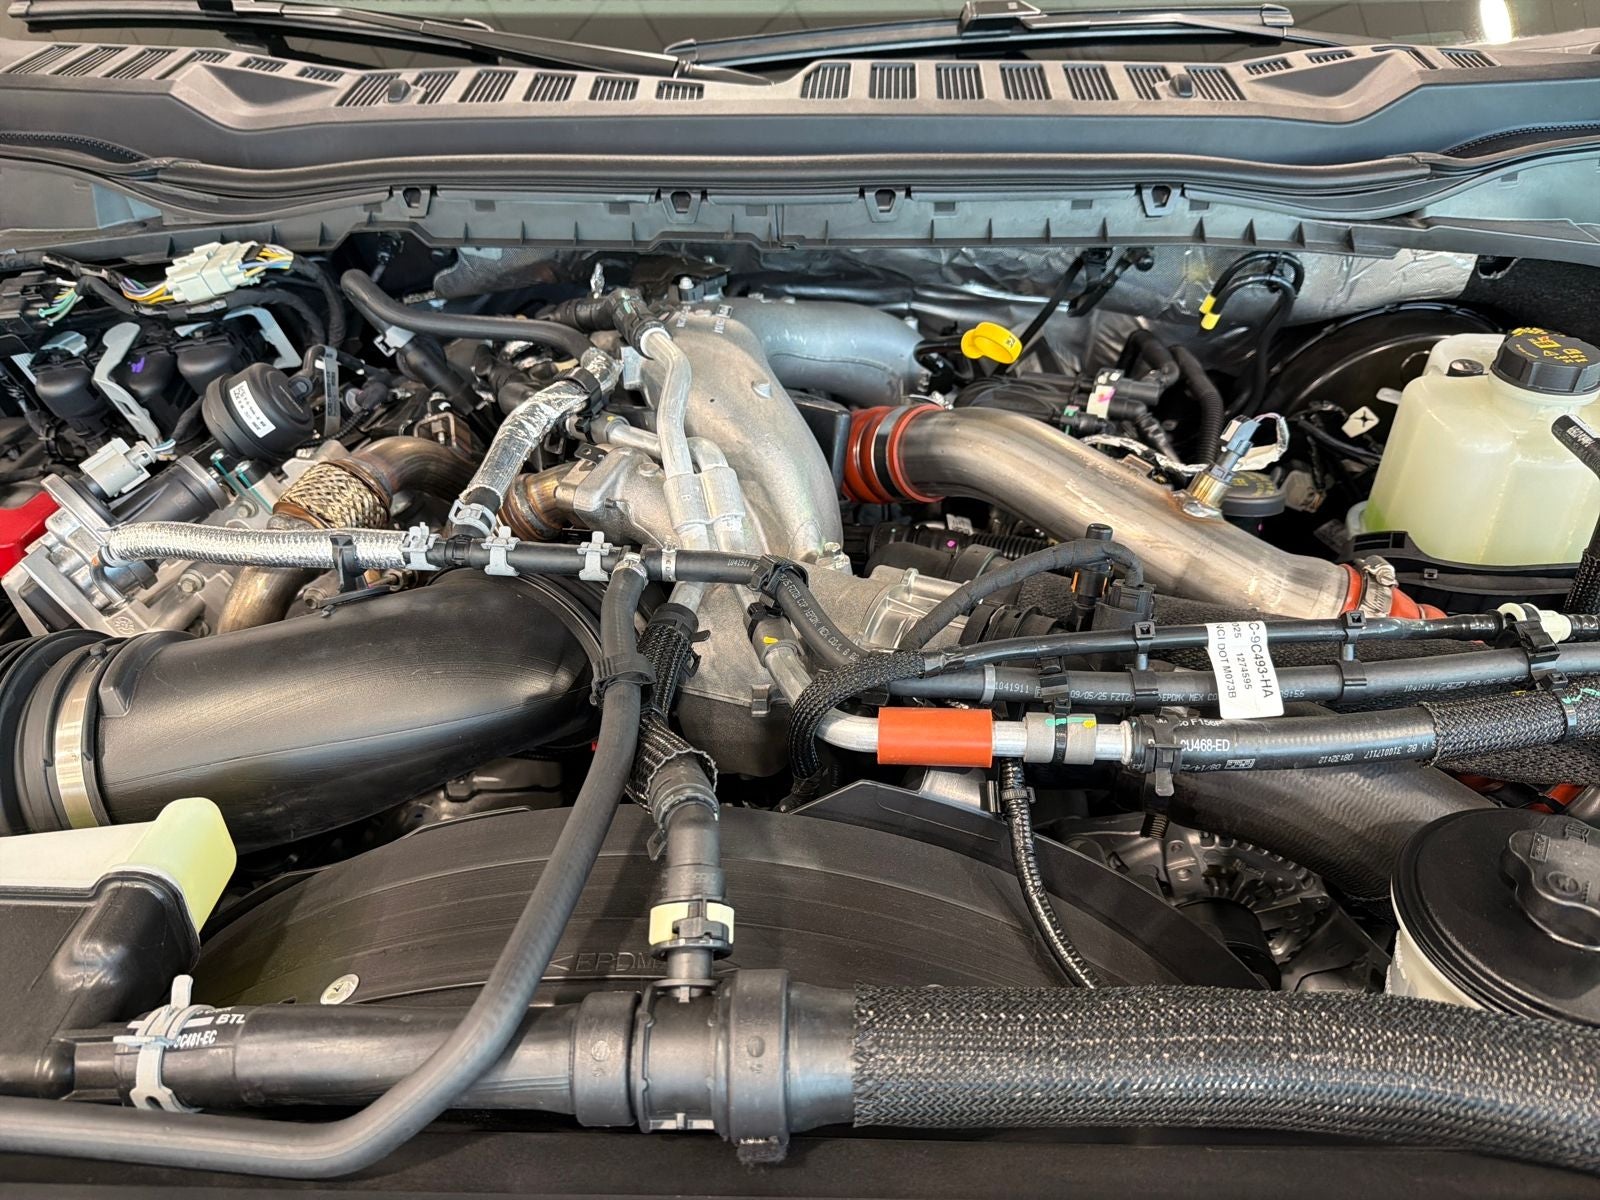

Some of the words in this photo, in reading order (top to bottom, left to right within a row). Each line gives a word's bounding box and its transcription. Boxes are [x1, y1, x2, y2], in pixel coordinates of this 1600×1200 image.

[1217, 644, 1230, 663] DOT
[1248, 622, 1274, 698] C-9C493-HA
[1223, 666, 1236, 698] M073B
[1236, 652, 1252, 690] 1274595
[1070, 690, 1107, 700] 09/05/25
[216, 1014, 246, 1024] BTL
